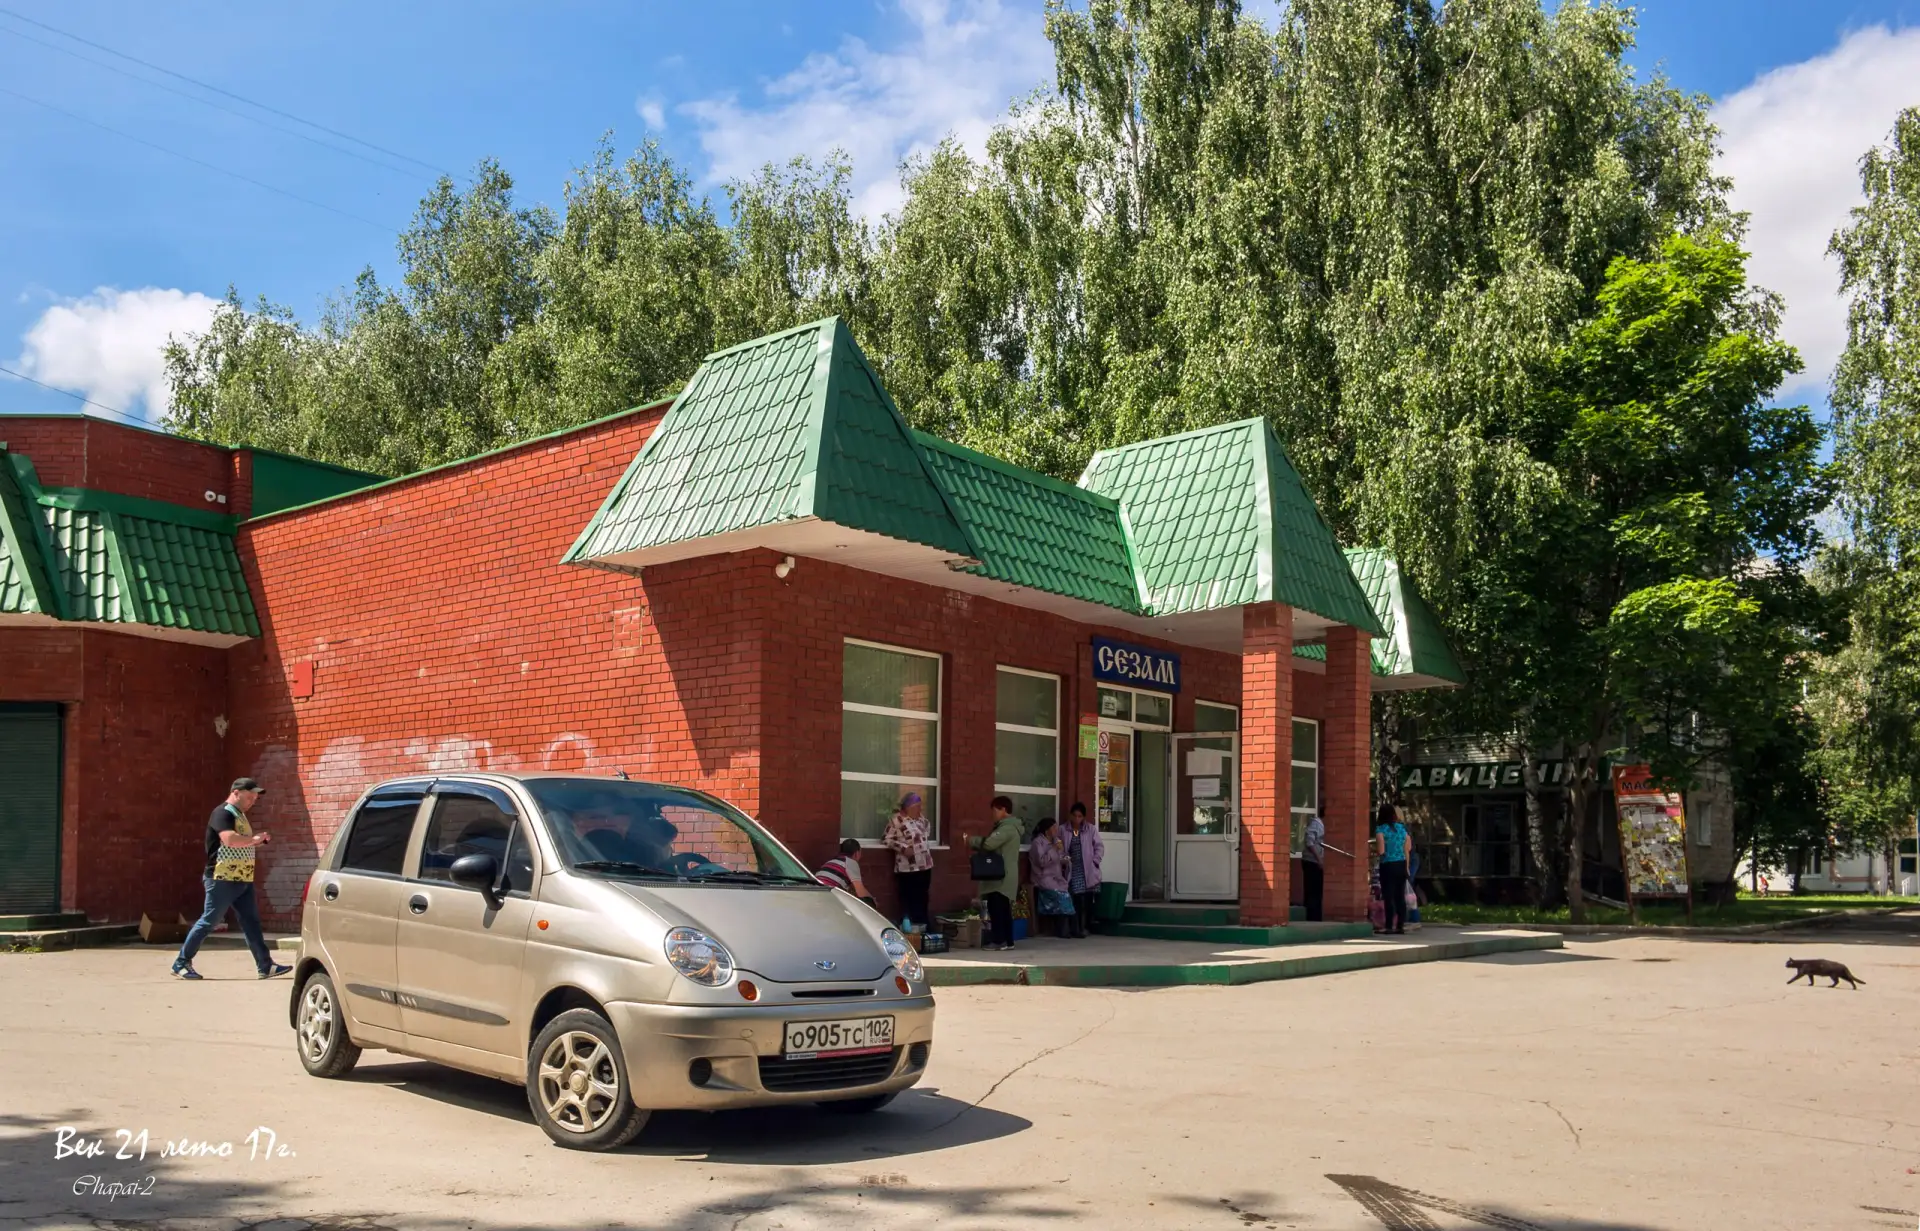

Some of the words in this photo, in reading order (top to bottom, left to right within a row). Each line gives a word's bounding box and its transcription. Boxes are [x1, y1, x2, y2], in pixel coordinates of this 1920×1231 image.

[1098, 645, 1177, 686] СЕЗАМ
[1401, 762, 1599, 789] АВИЦЕ
[792, 1023, 863, 1049] О905ТС
[866, 1019, 890, 1037] 102
